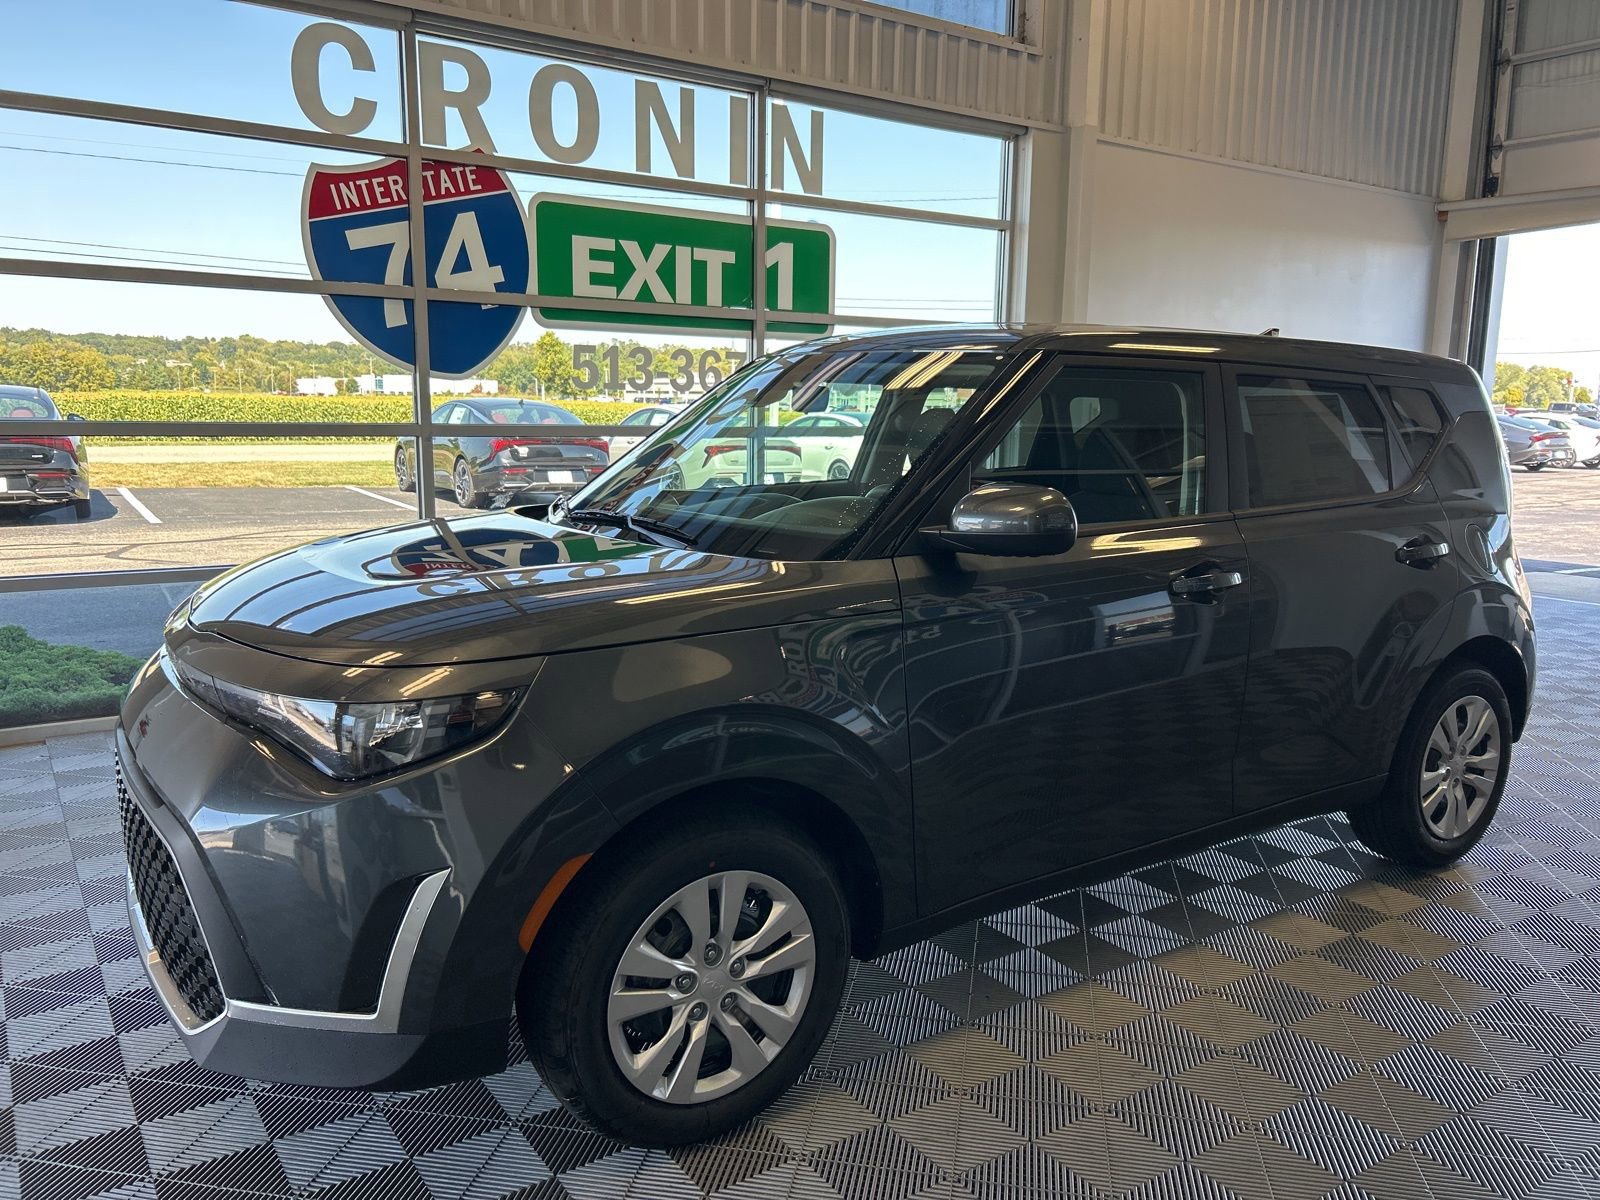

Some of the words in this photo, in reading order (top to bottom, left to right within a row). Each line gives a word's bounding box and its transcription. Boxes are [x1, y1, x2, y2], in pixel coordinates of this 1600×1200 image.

[291, 22, 824, 196] CRONIN
[330, 166, 482, 211] INTERTATE
[344, 211, 506, 329] 74
[571, 235, 736, 307] EXIT
[765, 242, 794, 311] 1
